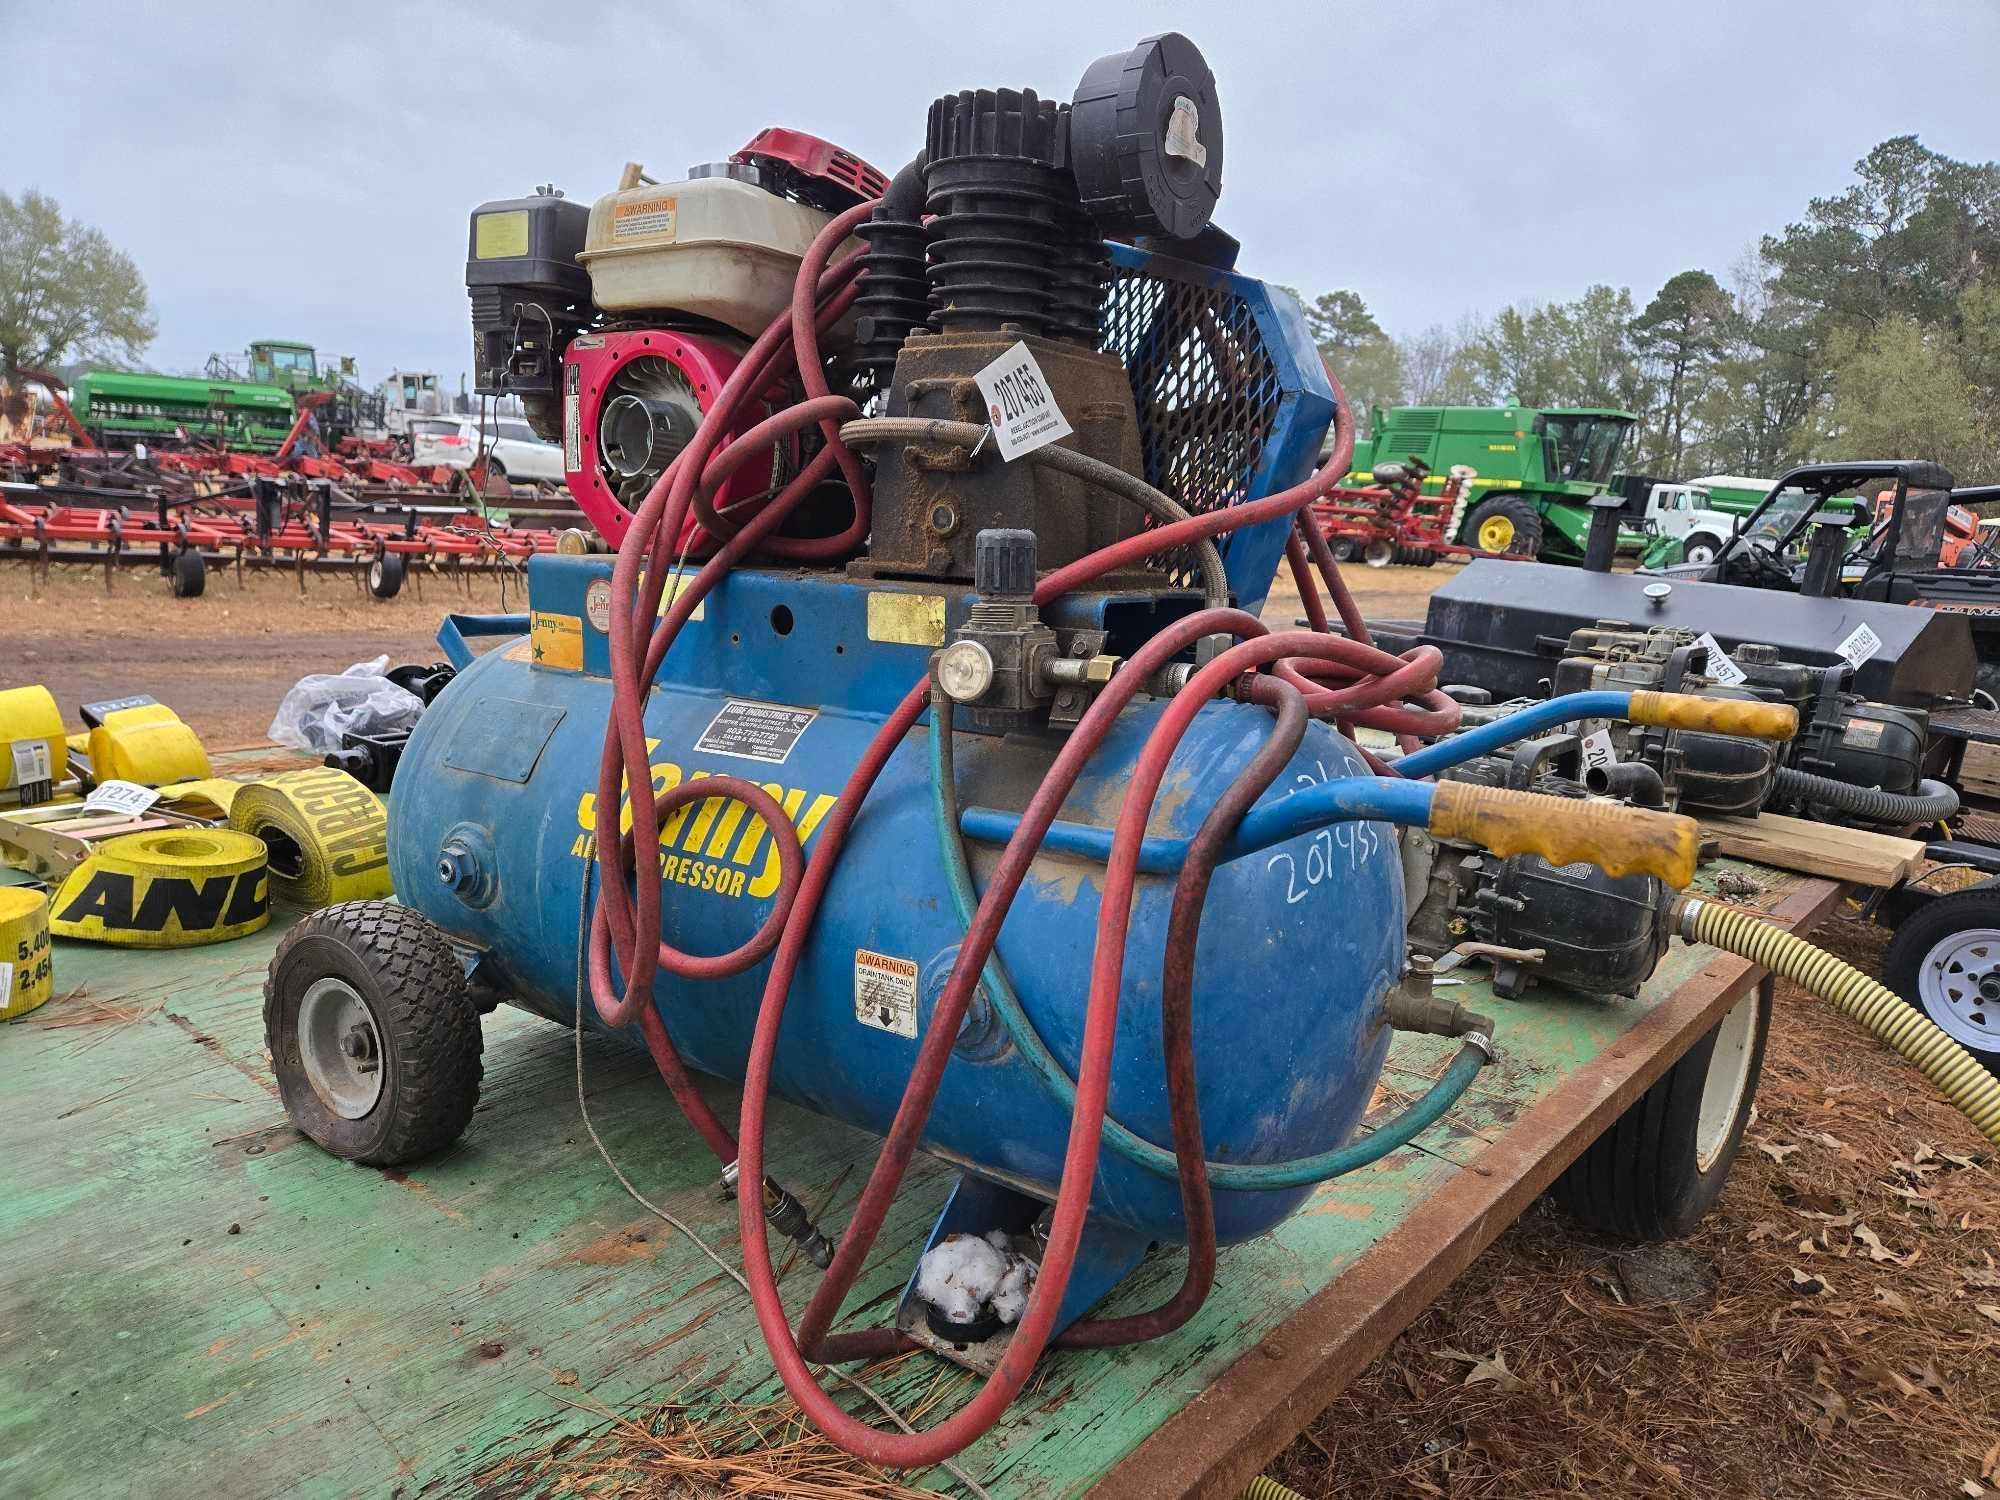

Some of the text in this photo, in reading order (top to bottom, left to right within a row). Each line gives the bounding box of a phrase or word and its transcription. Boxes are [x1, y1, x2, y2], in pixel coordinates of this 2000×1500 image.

[630, 200, 668, 215] WARNING
[994, 363, 1045, 421] 207455
[532, 612, 556, 634] Jenny
[727, 704, 748, 716] LUBE
[747, 737, 775, 746] SERVICE
[865, 955, 915, 976] WARNING
[858, 967, 913, 987] DRAIN TANK DAILY
